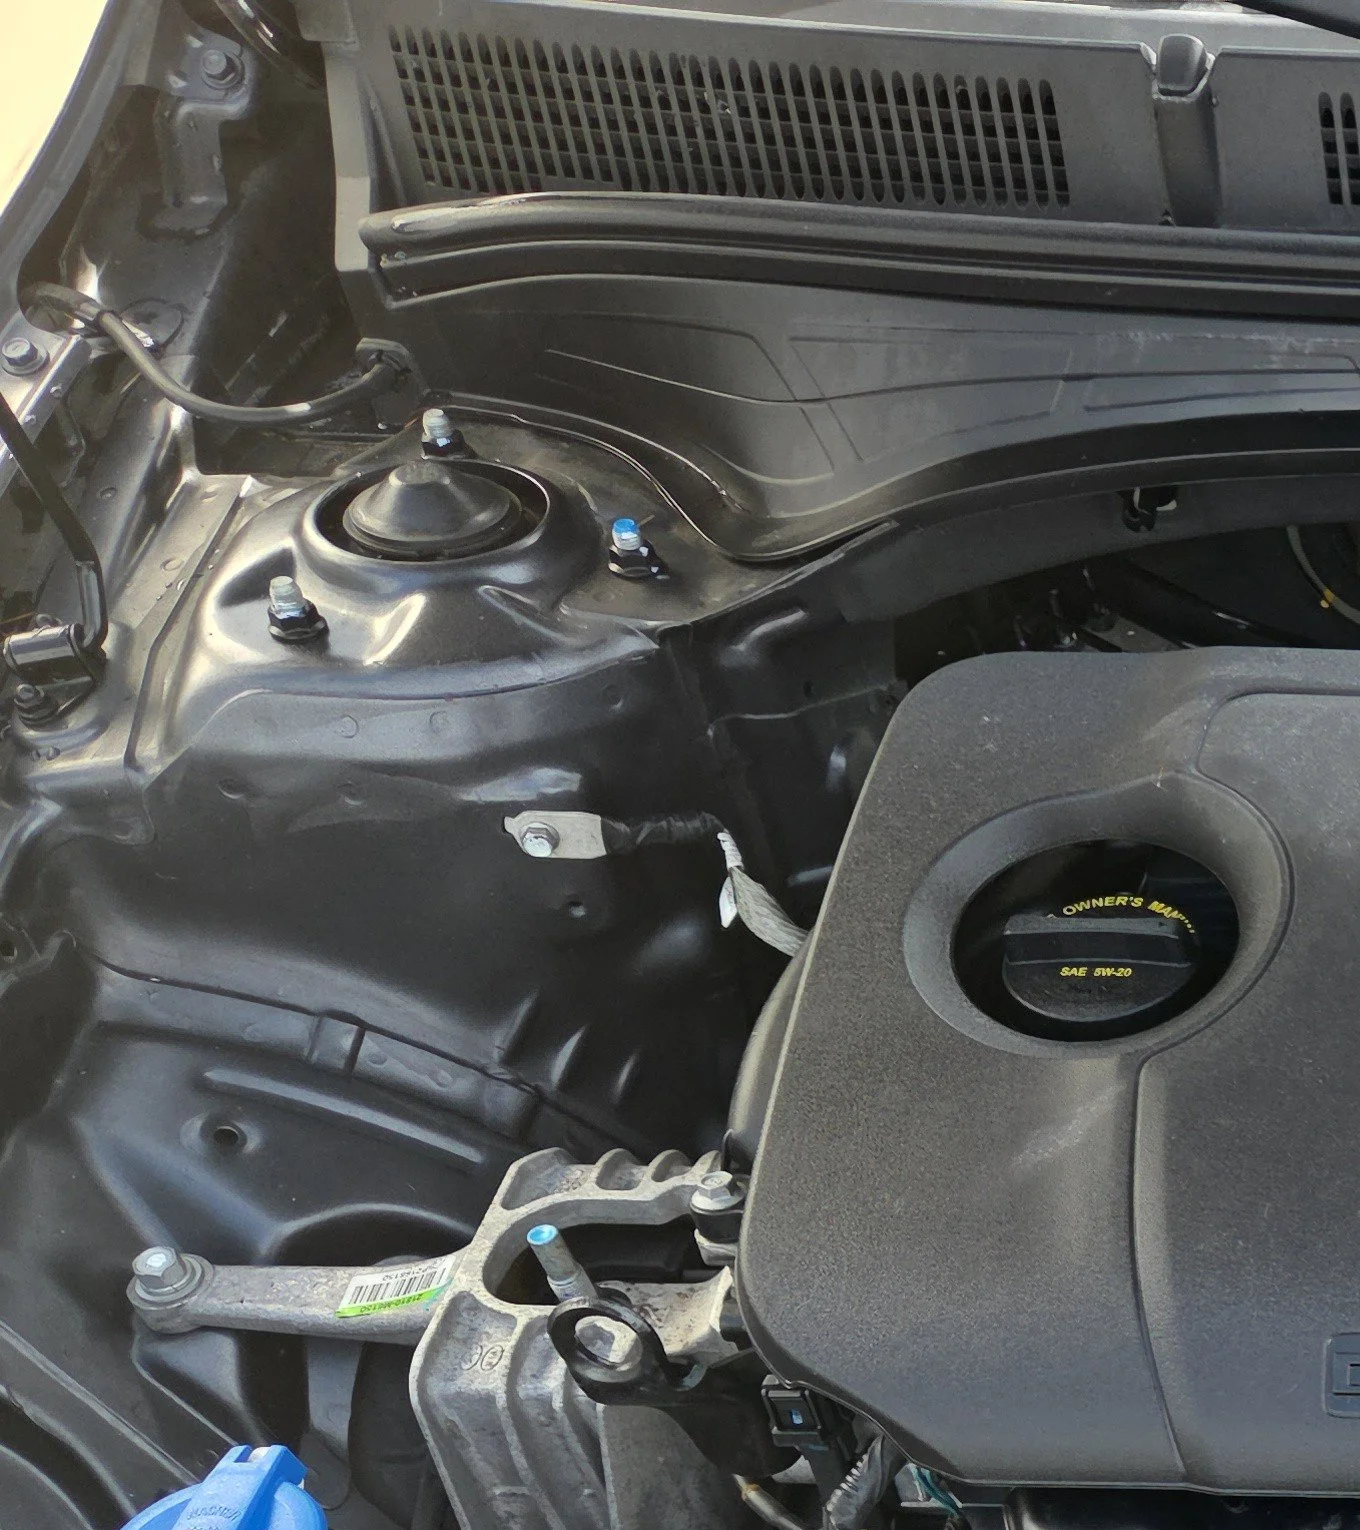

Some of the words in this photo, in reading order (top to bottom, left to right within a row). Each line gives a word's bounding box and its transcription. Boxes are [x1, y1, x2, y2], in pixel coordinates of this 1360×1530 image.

[1062, 896, 1144, 916] OWNER'S
[1060, 966, 1087, 978] SAE
[1093, 967, 1132, 978] 5W-20
